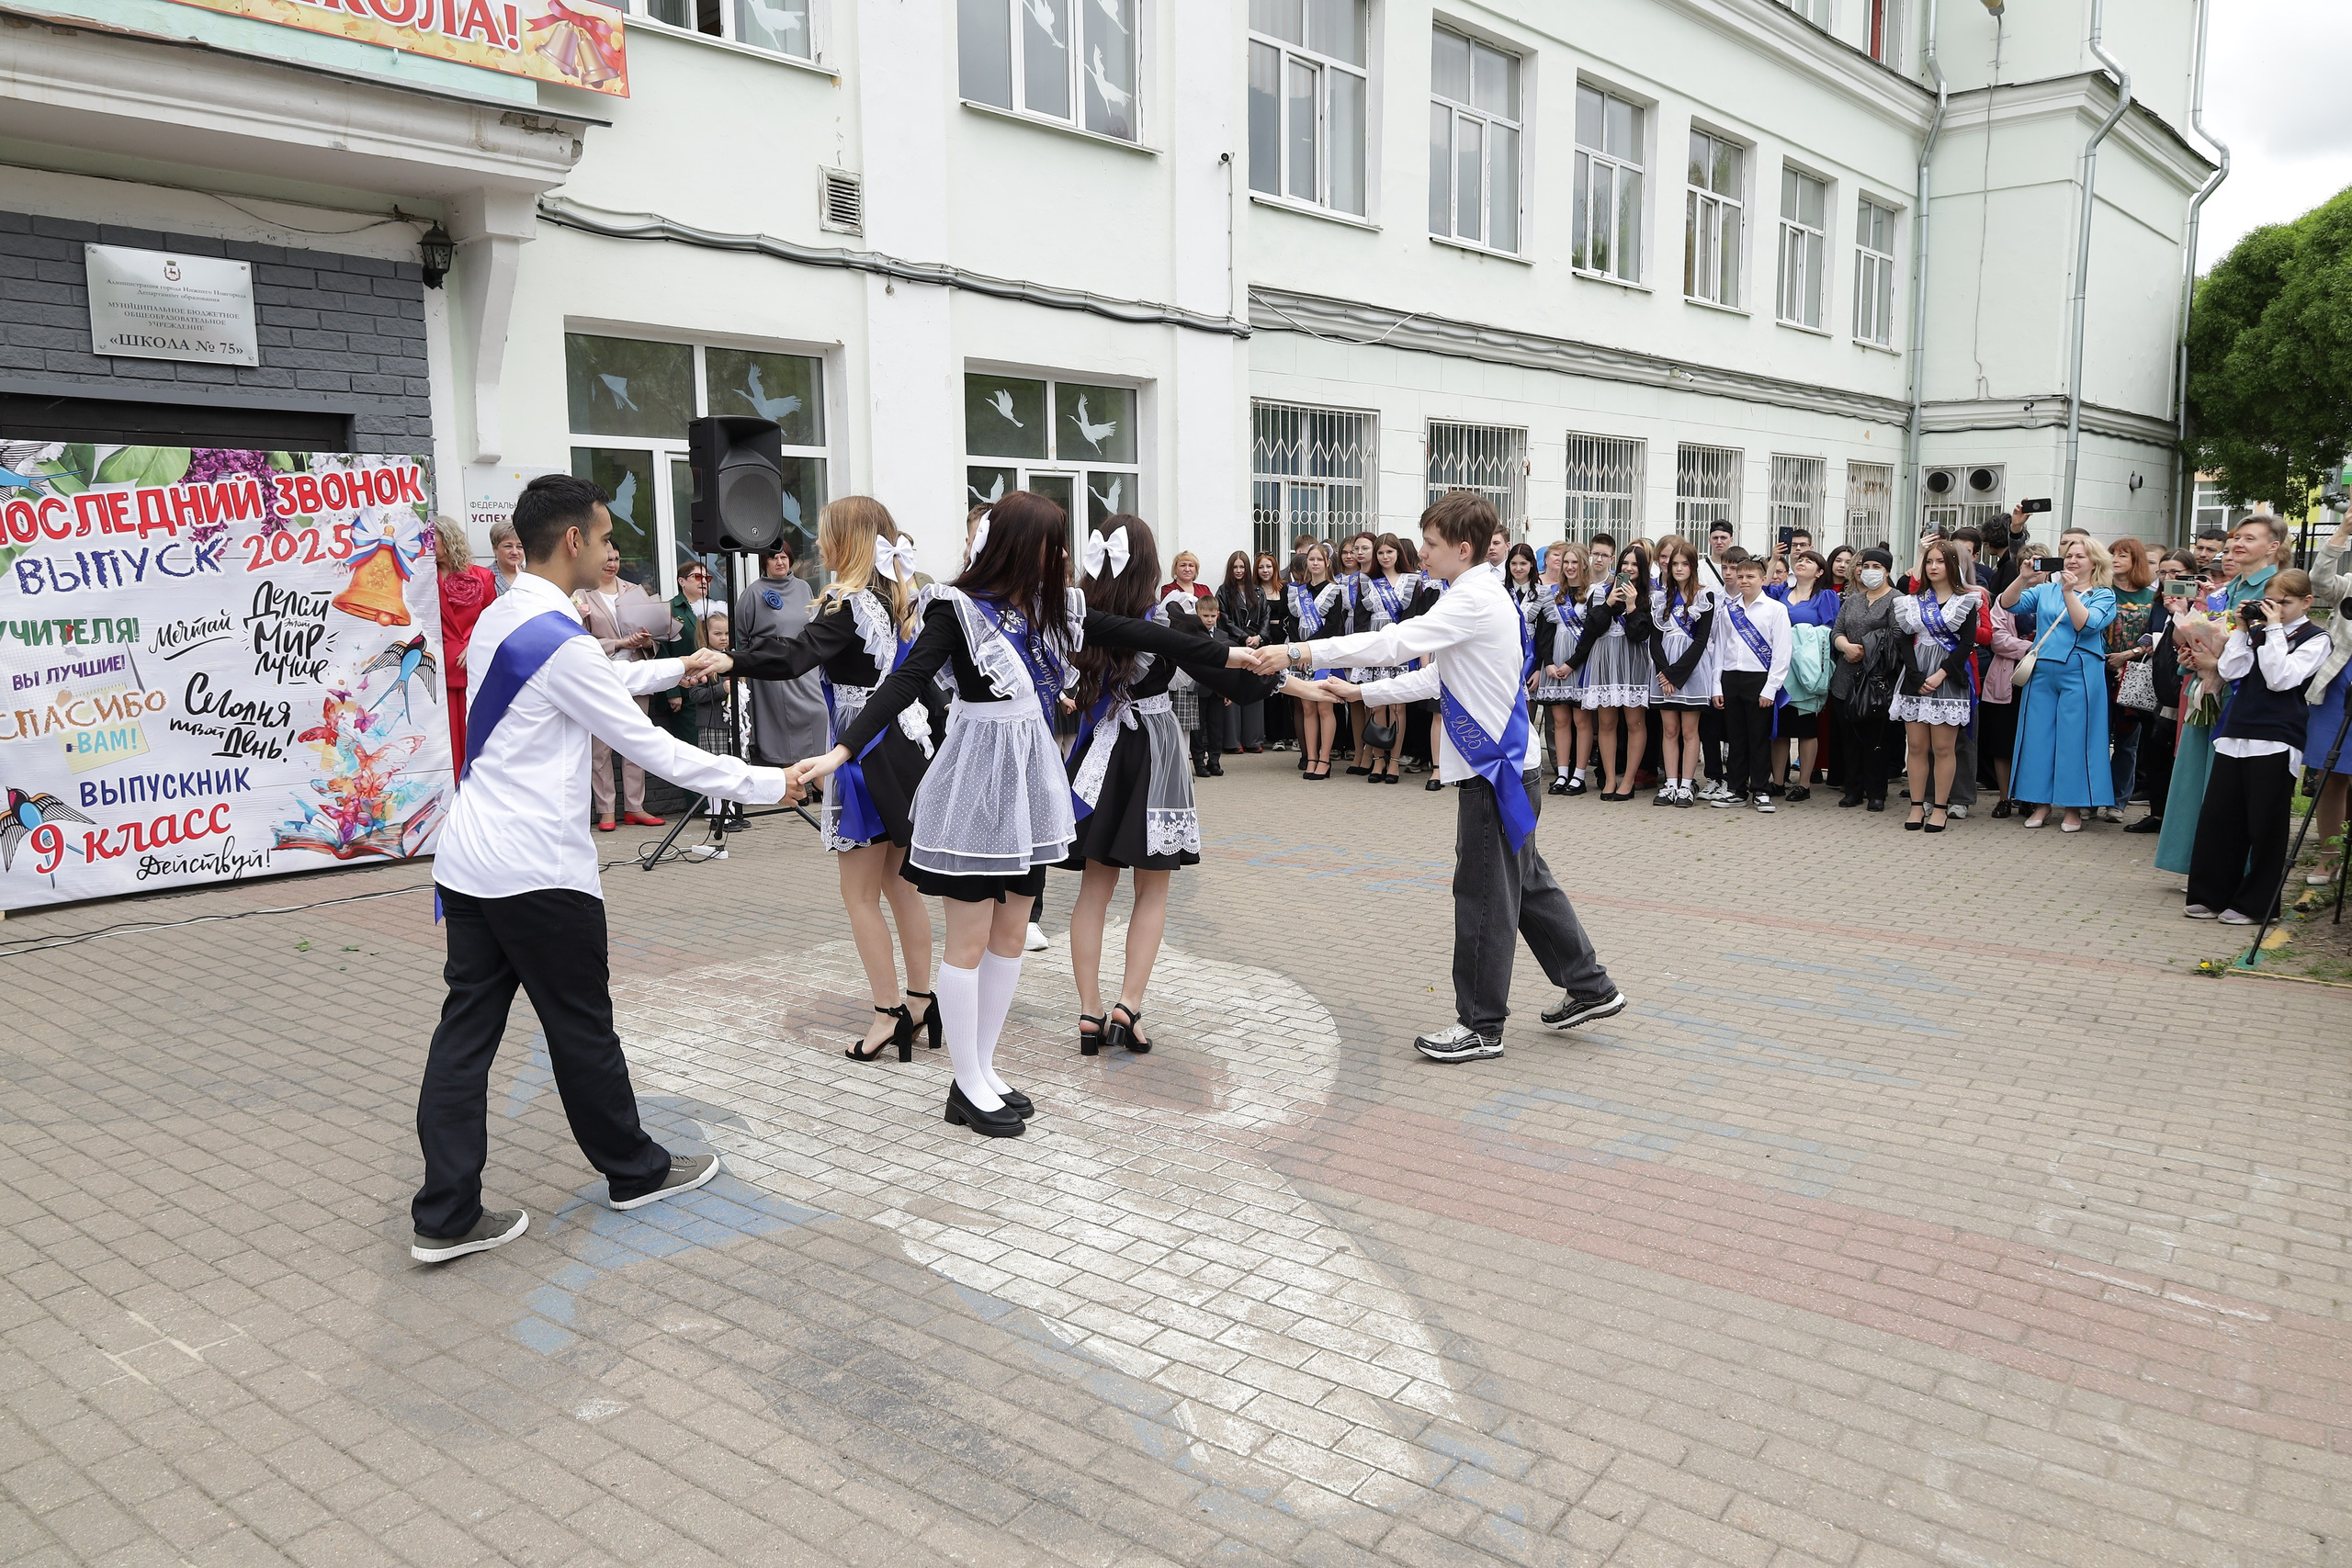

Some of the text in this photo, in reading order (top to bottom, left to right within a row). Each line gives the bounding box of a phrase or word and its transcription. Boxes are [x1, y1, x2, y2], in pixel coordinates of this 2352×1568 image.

[107, 278, 159, 288] Администрация
[183, 286, 212, 295] Нижнего
[213, 289, 246, 299] Новгорода
[137, 289, 220, 302] Департамент образования
[107, 301, 241, 320] МУНИЦИПАЛЬНОЕ БЮДЖЕТНОЕ
[124, 310, 227, 325] ОБЩЕОБРАЗОВАТЕЛЬНОЕ
[148, 321, 205, 332] УЧРЕЖДЕНИЕ
[109, 333, 243, 355] «ШКОЛА № 75»
[0, 467, 425, 545] ОСЛЕДНИЙ ЗВОНОК
[470, 513, 507, 523] УСПЕХ
[16, 524, 355, 595] ВЫПУСК 2025
[148, 609, 236, 654] Мечтай
[12, 654, 126, 691] ВЫ ЛУЧШИЕ!
[185, 671, 291, 728] Сегодня
[77, 728, 137, 754] ВАМ!
[1450, 715, 1489, 750] 2025
[80, 766, 252, 807] ВЫПУСКНИК
[30, 802, 232, 874] 9 класс
[136, 835, 271, 881] Действуй!
